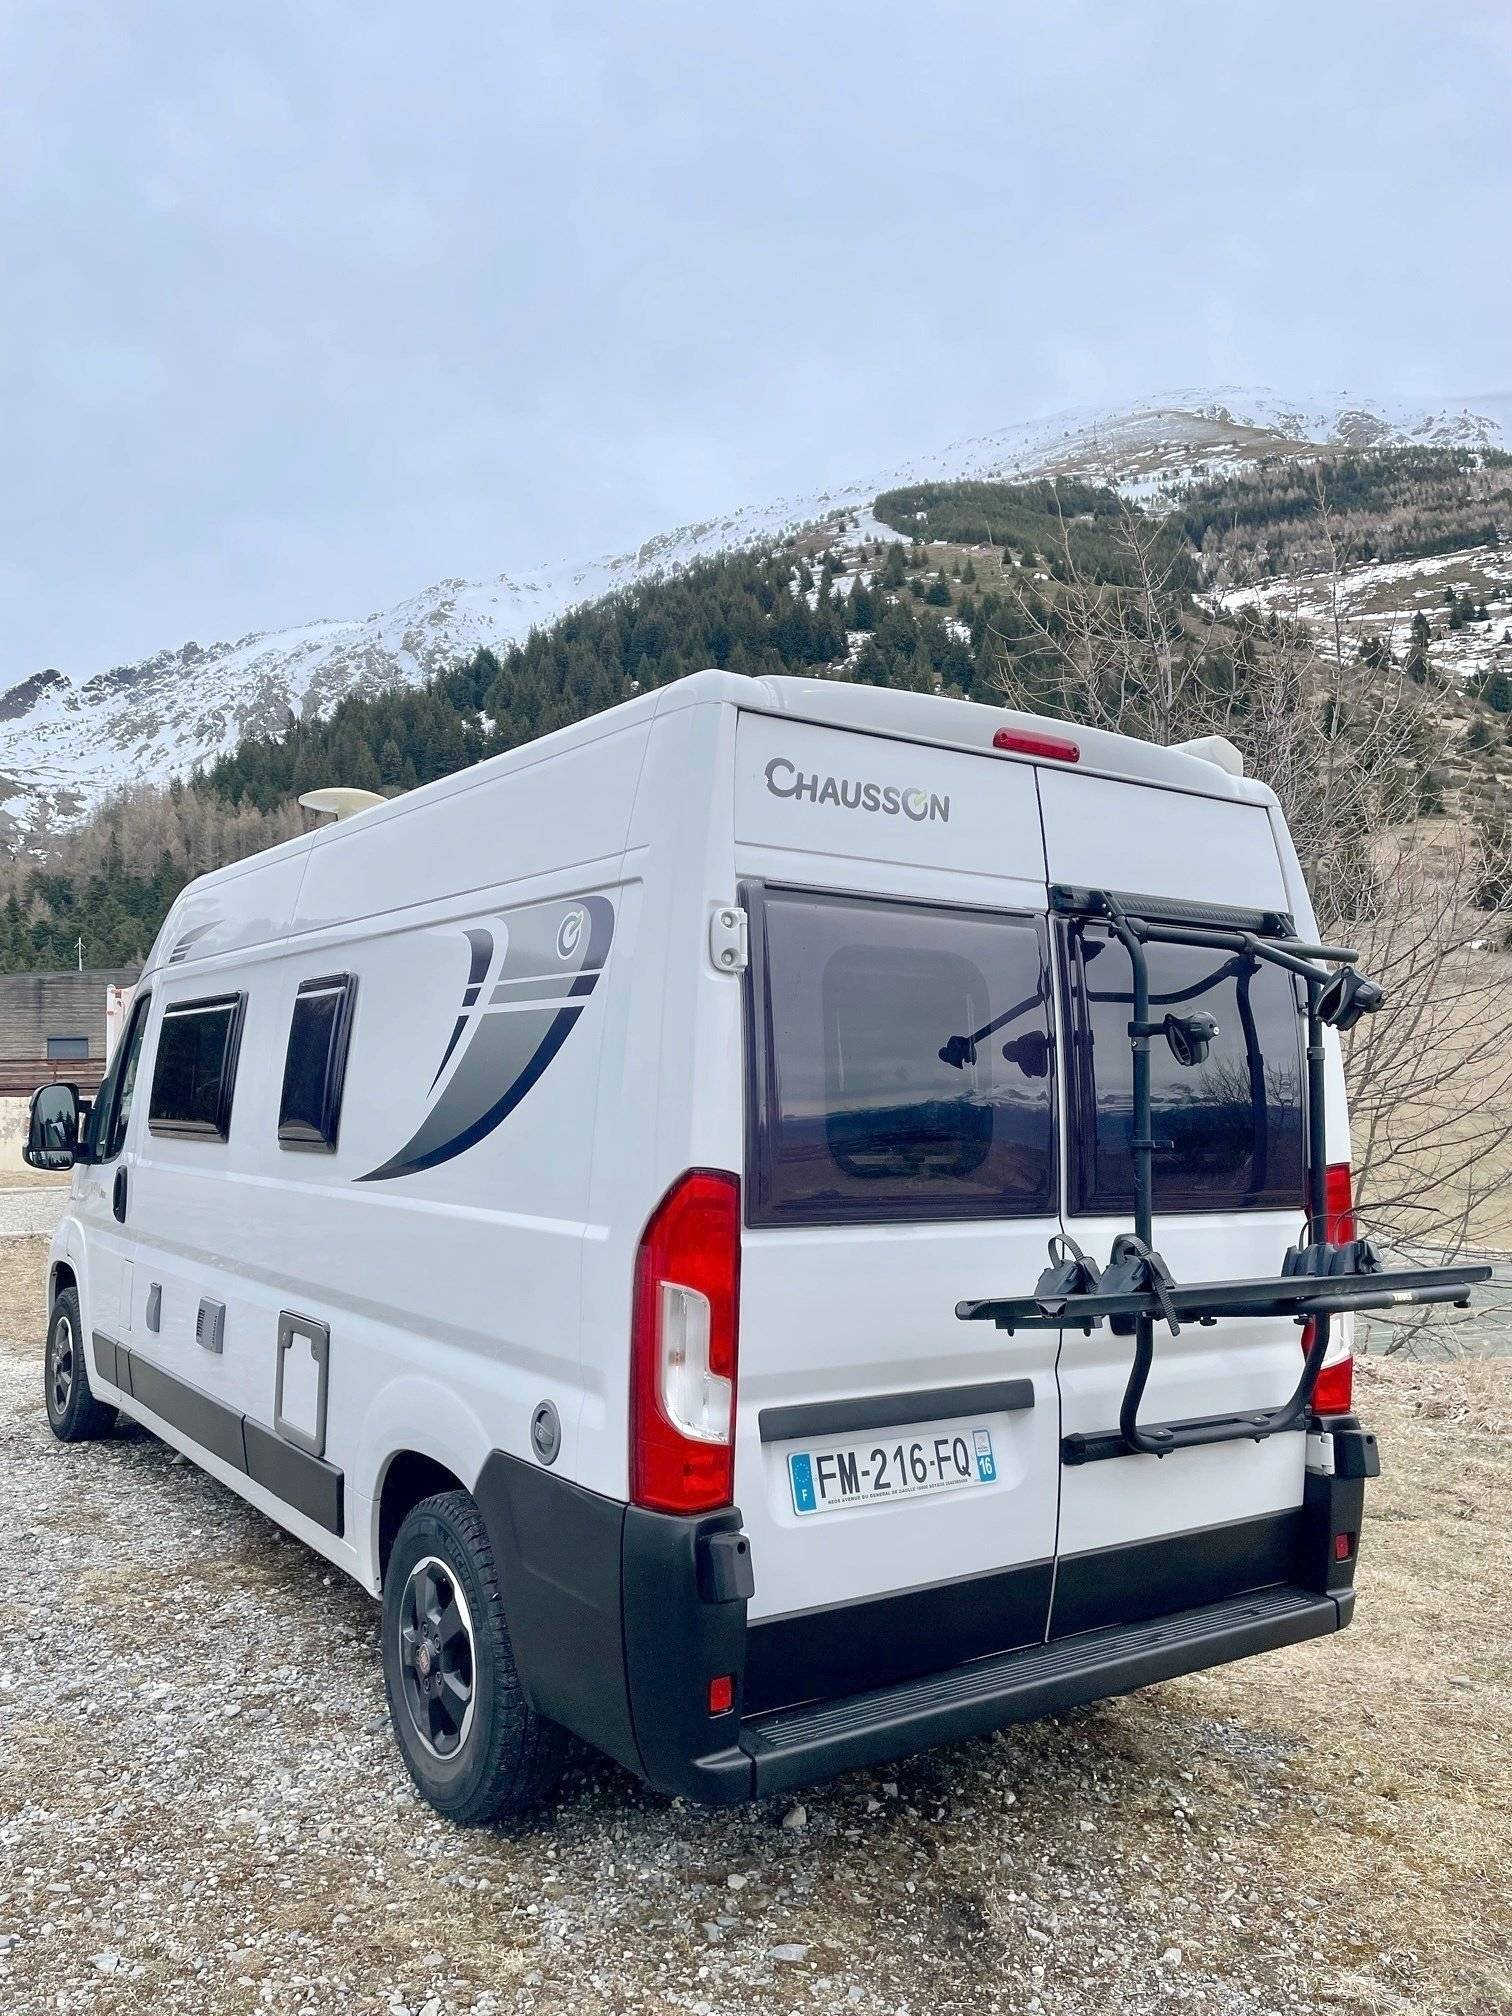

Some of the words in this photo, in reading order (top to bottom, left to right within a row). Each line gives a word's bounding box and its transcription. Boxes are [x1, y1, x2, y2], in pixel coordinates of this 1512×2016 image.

[764, 757, 950, 823] CHAUSSON
[815, 1437, 972, 1499] FM-216-FQ
[979, 1456, 993, 1475] 16
[801, 1488, 808, 1502] F
